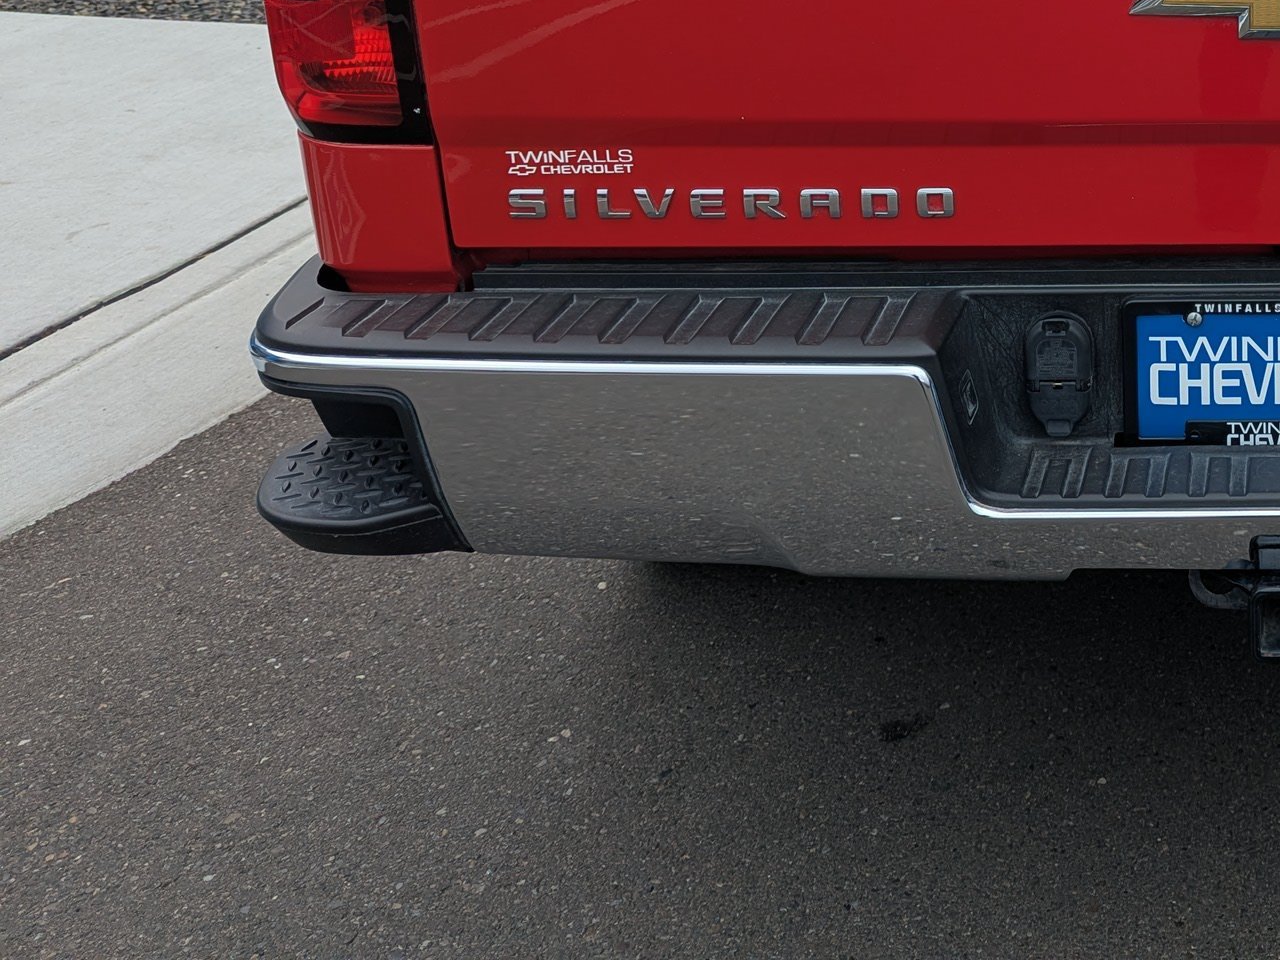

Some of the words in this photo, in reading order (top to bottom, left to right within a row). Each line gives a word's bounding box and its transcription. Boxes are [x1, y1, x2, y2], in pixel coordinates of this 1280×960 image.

[505, 149, 633, 164] TWINFALLS
[540, 164, 634, 175] CHEVROLET
[508, 188, 955, 219] SILVERADO
